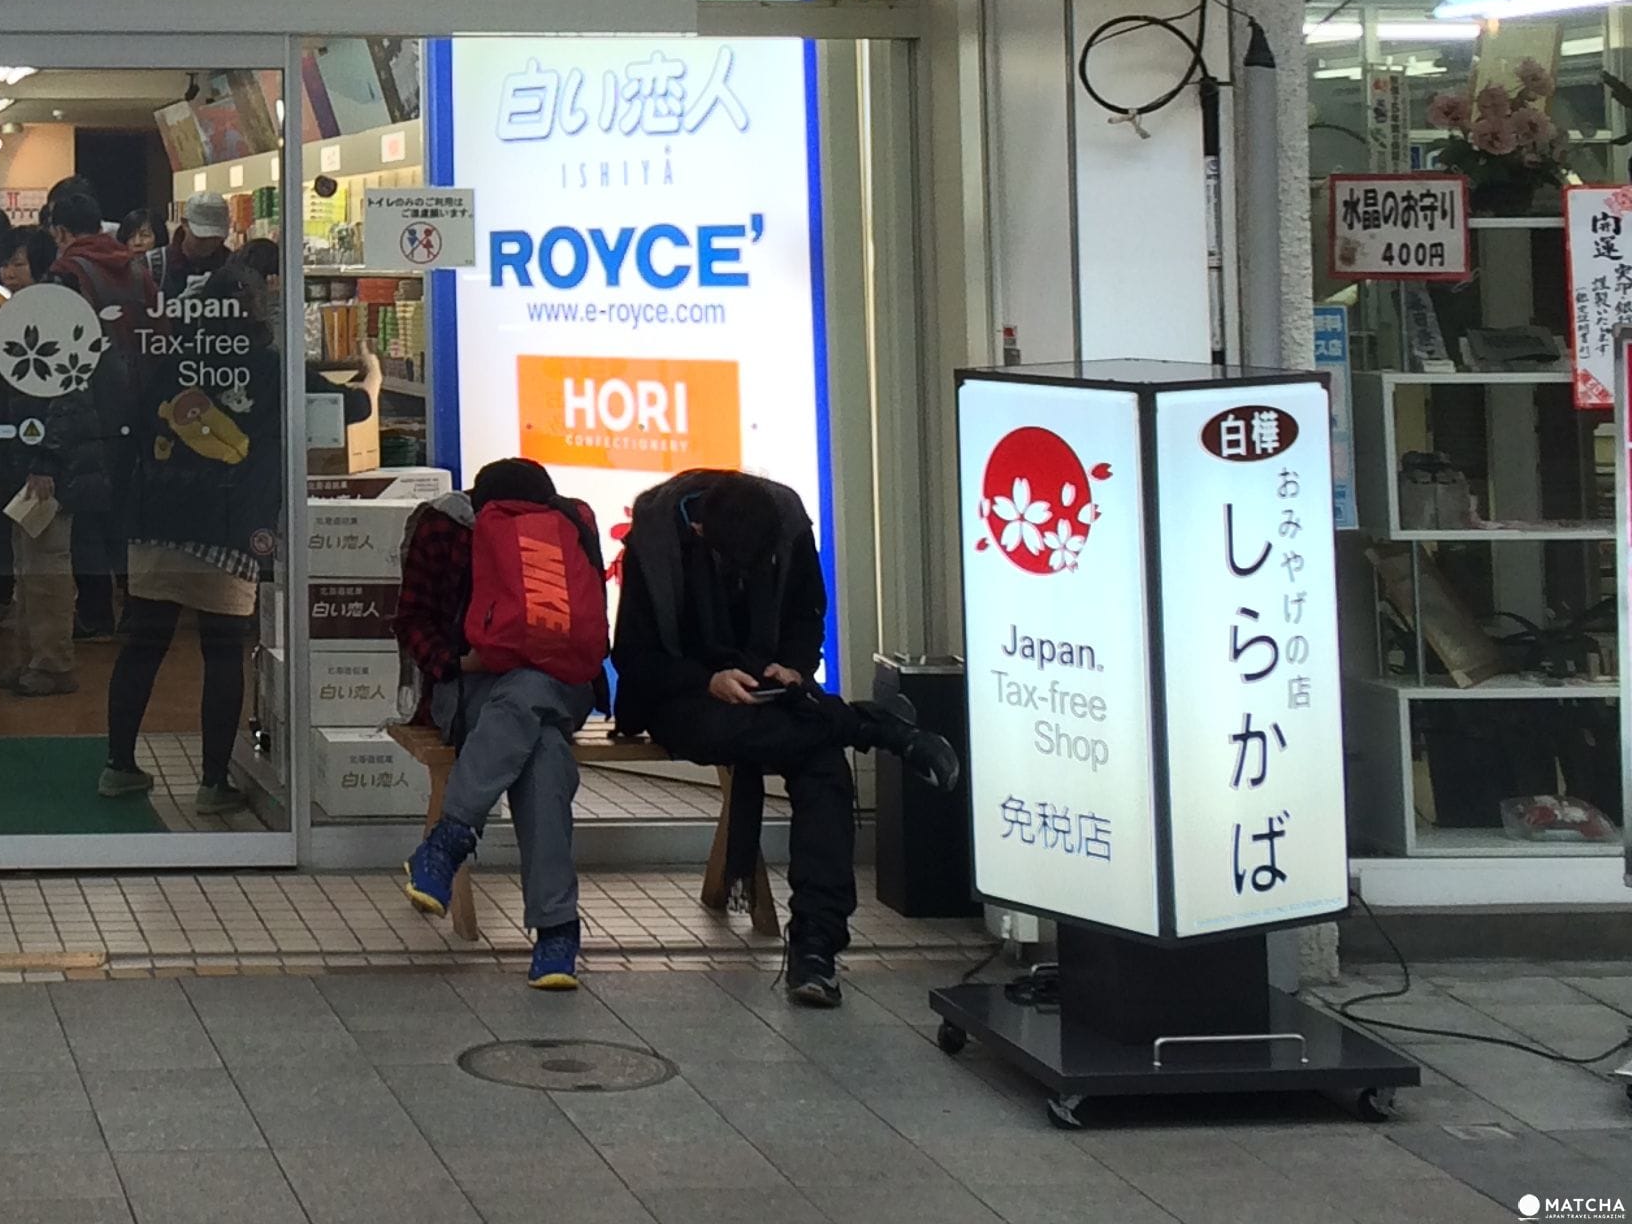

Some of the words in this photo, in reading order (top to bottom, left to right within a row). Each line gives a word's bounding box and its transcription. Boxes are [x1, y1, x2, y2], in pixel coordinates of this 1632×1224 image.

[494, 45, 751, 142] 白い恋人
[1342, 187, 1455, 231] 水晶のお守り
[1381, 242, 1445, 267] 400円
[146, 292, 248, 325] Japan.
[527, 301, 725, 330] www.e-royce.com
[134, 328, 250, 357] Tax-free
[177, 360, 250, 394] Shop
[563, 377, 689, 434] HORI
[1219, 410, 1281, 458] 白樺
[308, 534, 374, 550] 白い恋人
[518, 536, 571, 634] NIKE
[1275, 465, 1313, 711] おみやげの店
[311, 601, 380, 618] 白い恋人
[1001, 624, 1105, 673] Japan.
[319, 684, 386, 701] 白い恋人
[990, 669, 1108, 722] Tax-free
[1221, 502, 1292, 897] しらかば
[1033, 719, 1109, 772] Shop
[341, 772, 410, 789] 白い恋人
[1000, 793, 1112, 863] 免税店
